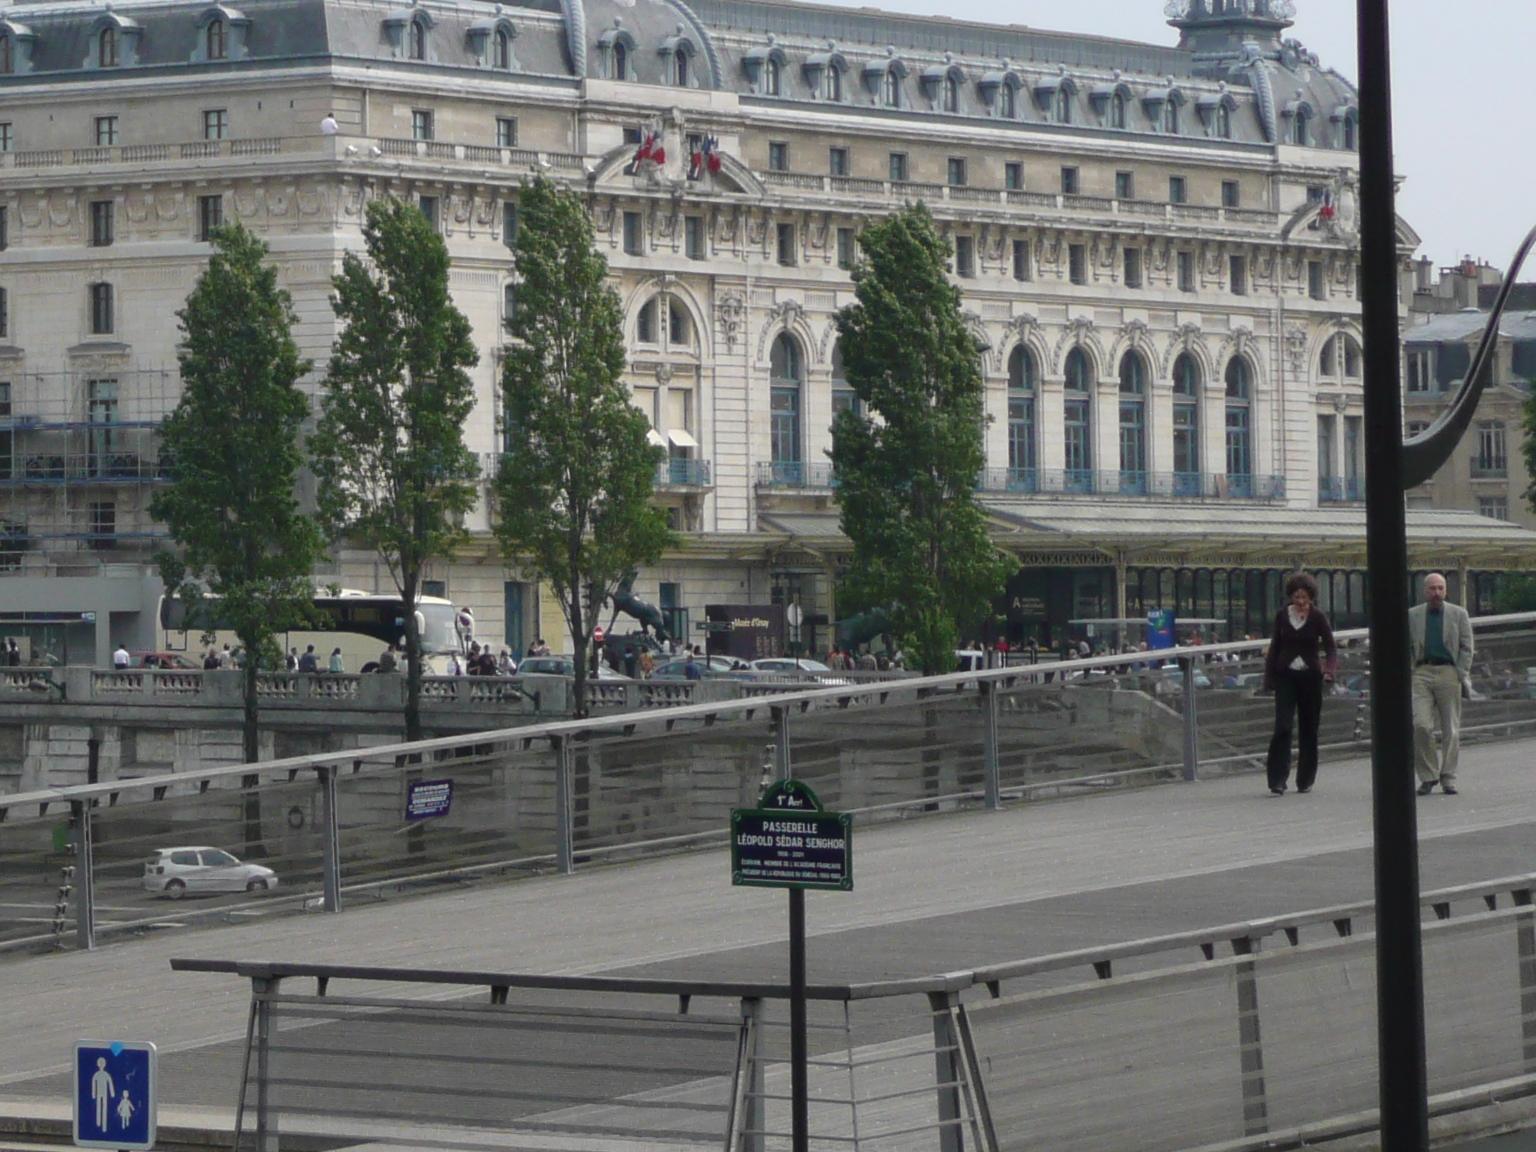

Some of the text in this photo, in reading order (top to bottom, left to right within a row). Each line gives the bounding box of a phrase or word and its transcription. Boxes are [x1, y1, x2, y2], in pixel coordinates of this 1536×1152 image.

[1013, 597, 1021, 608] A
[762, 821, 818, 834] PASSERELLE
[737, 833, 845, 849] LÉOPOLD SÉDAR SENGHOR
